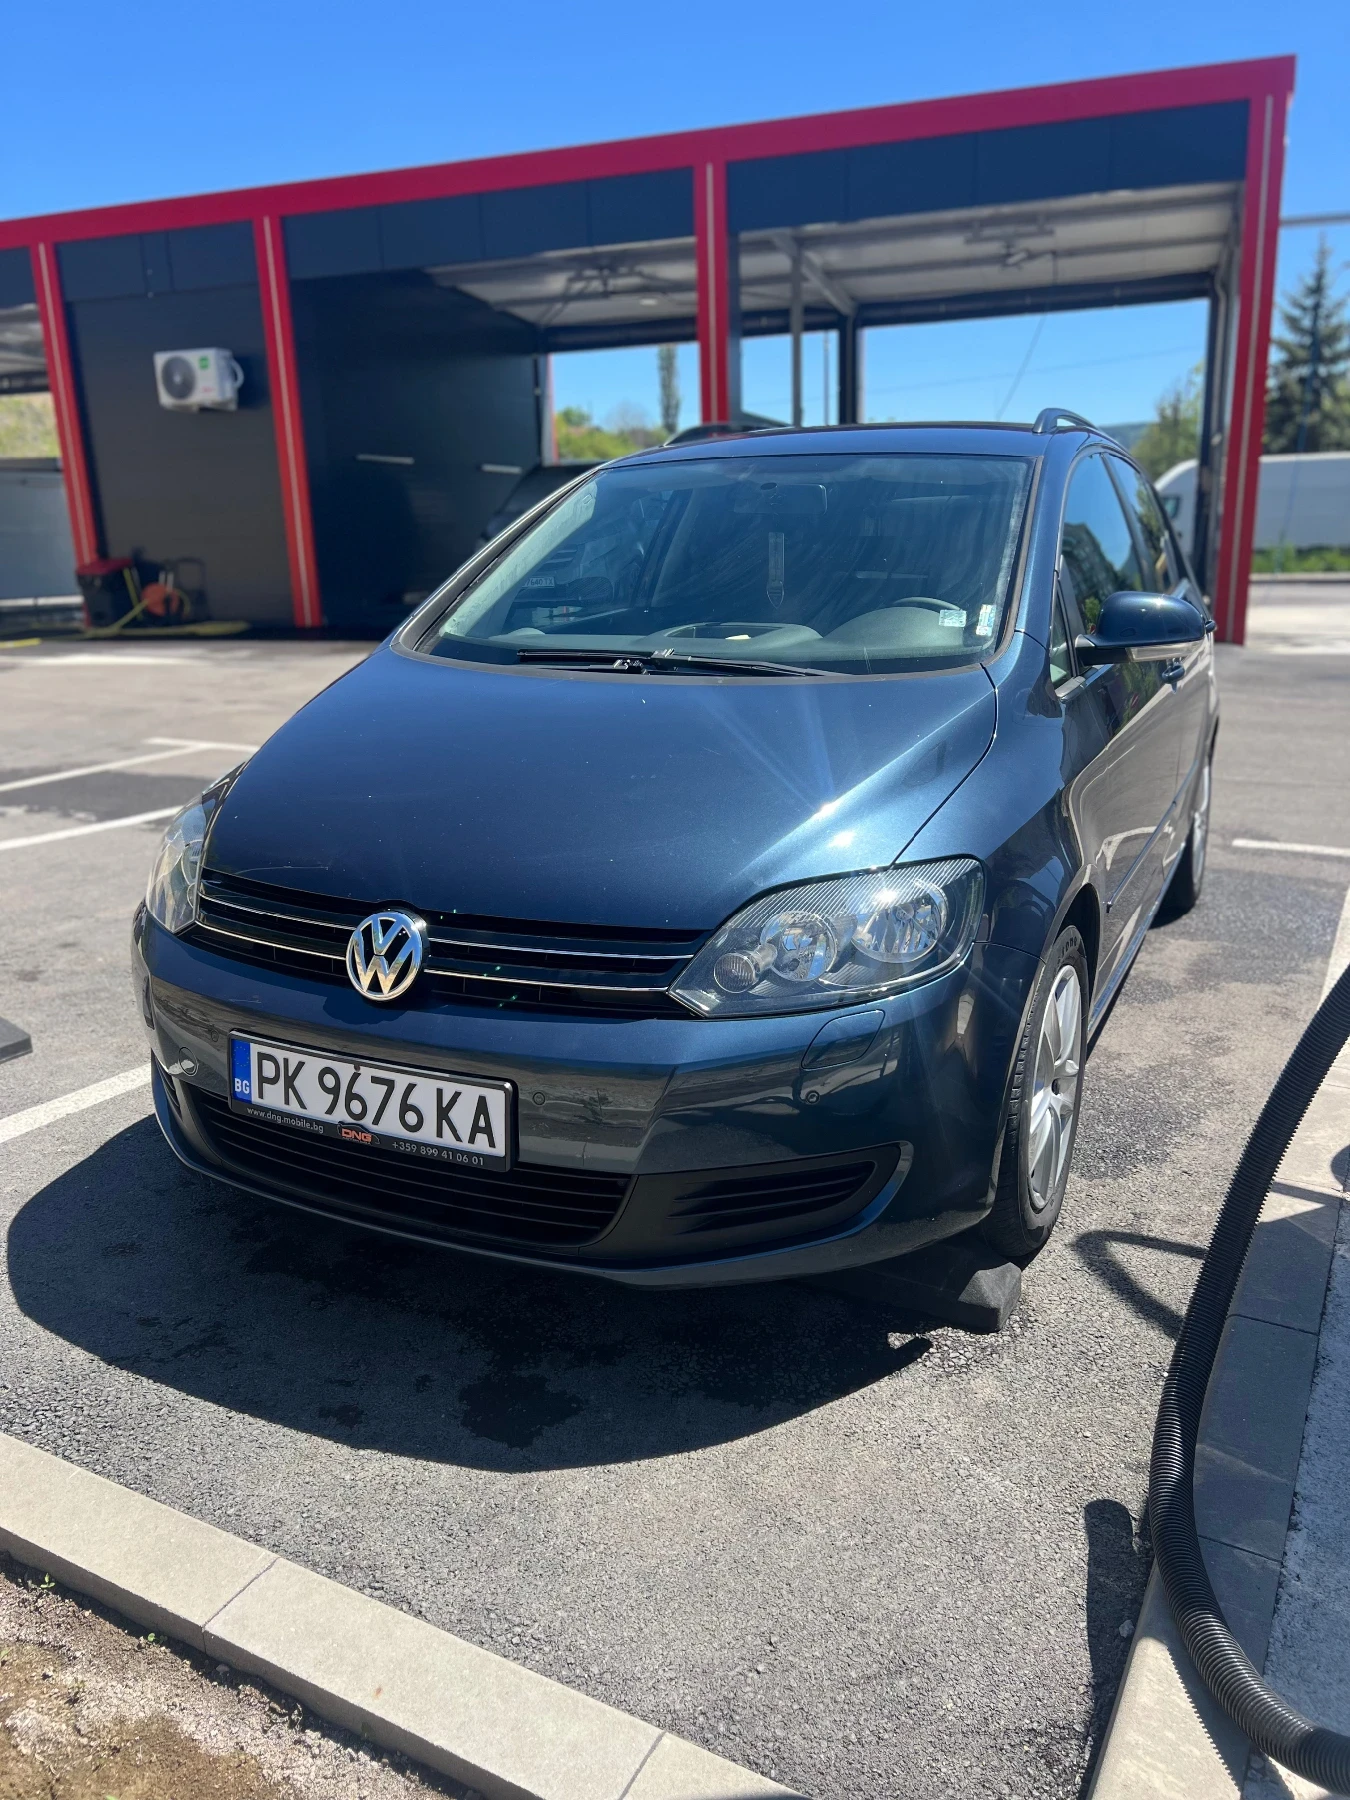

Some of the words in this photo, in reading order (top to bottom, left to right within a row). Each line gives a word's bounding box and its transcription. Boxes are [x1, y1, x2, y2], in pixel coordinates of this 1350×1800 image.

[346, 912, 422, 1001] VW
[234, 1078, 250, 1094] BG
[257, 1051, 307, 1110] PK
[317, 1066, 424, 1133] 9676
[436, 1087, 496, 1149] KA
[247, 1107, 324, 1134] www.dng.mobile.bg
[341, 1128, 372, 1143] DNG
[392, 1141, 417, 1153] +359
[420, 1146, 438, 1157] 899
[441, 1150, 453, 1160] 41
[456, 1153, 469, 1163] 06
[471, 1156, 484, 1166] 01
